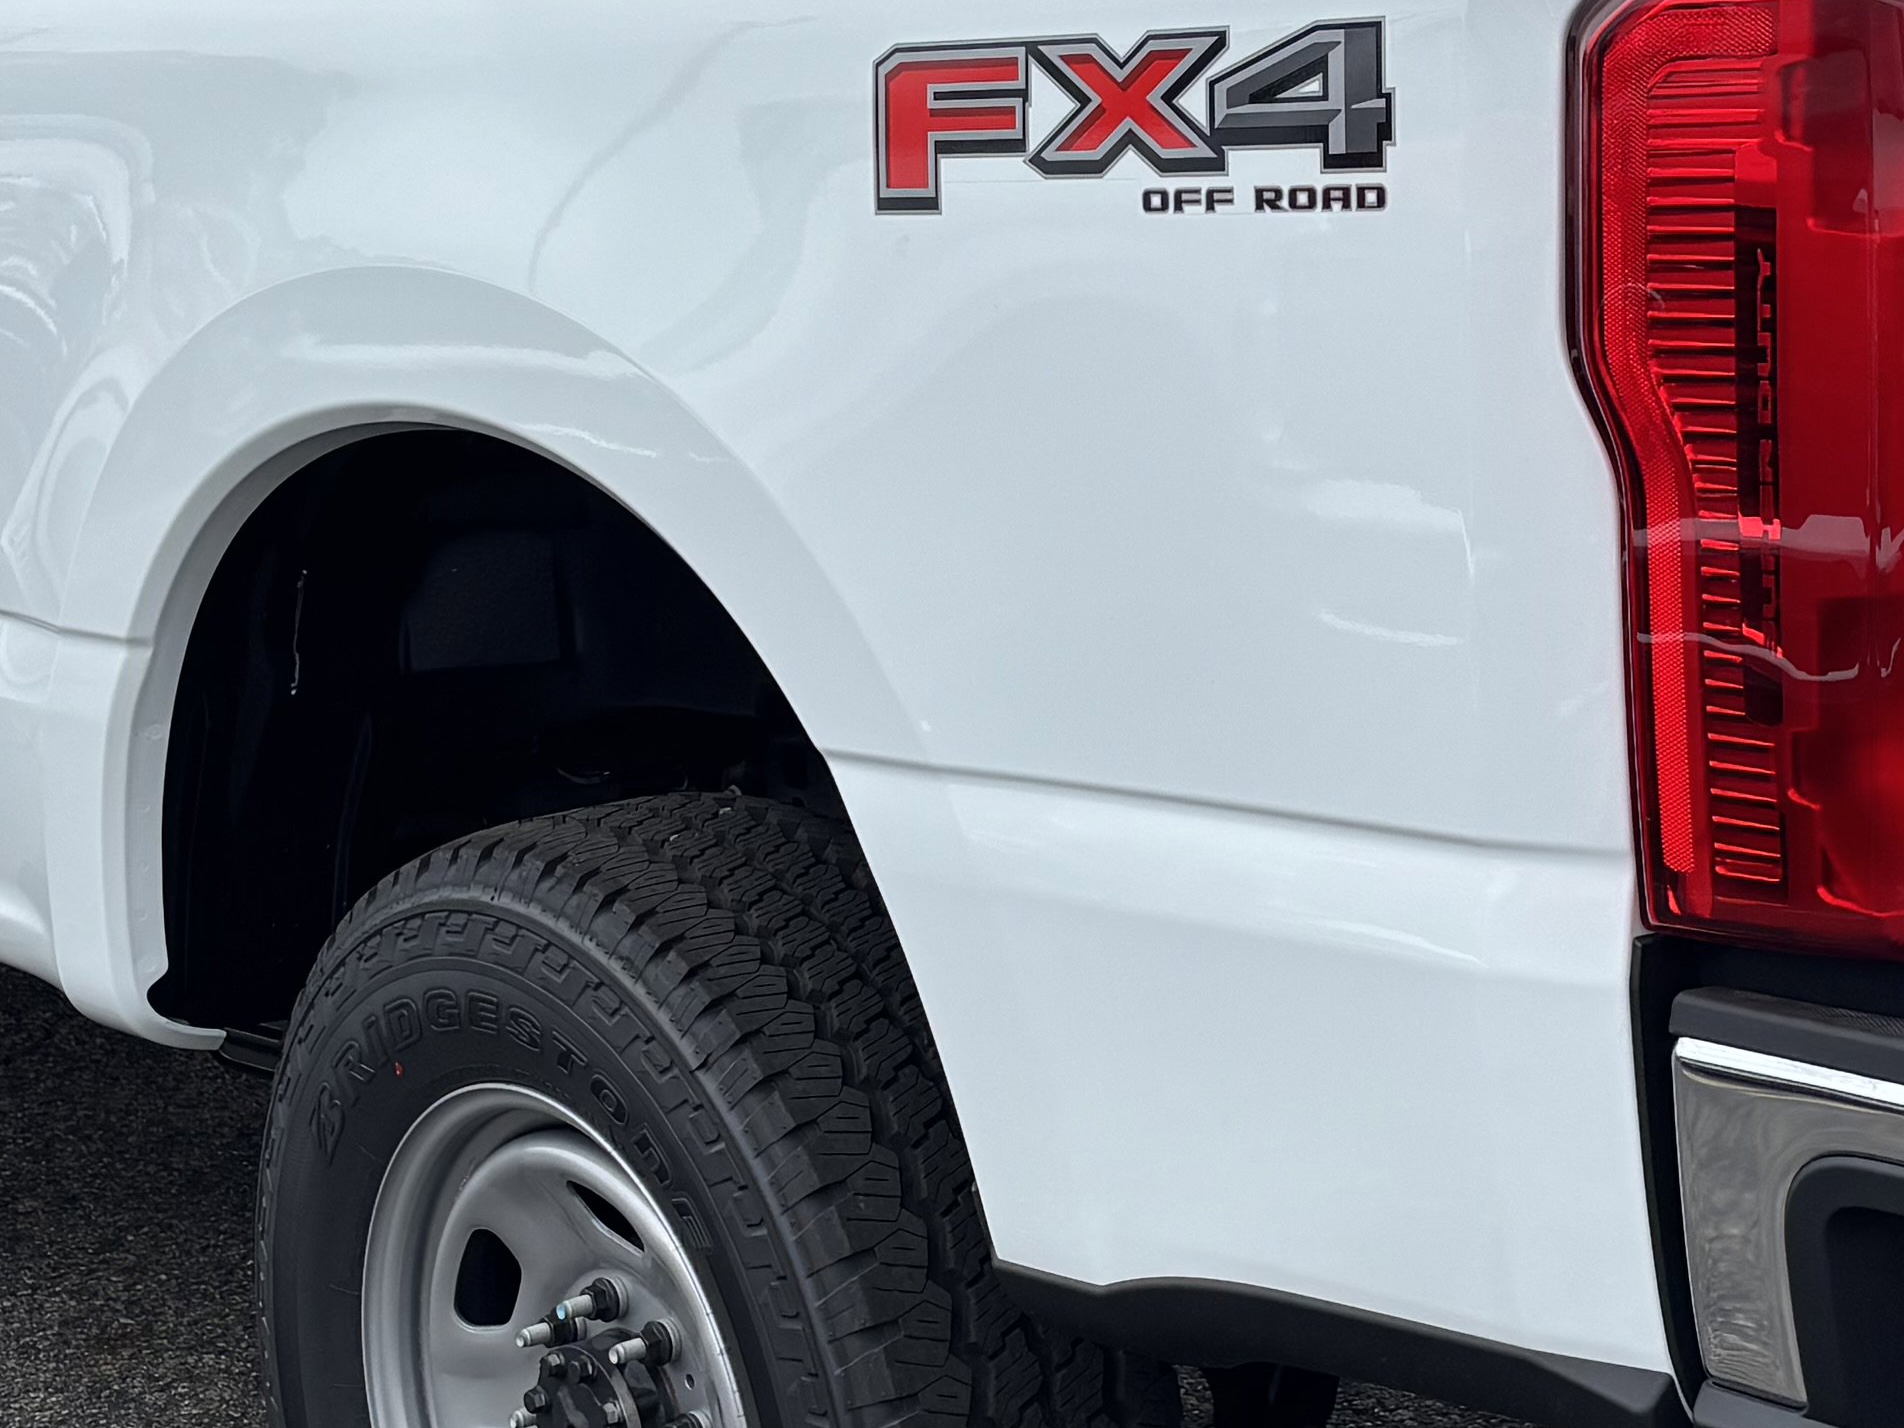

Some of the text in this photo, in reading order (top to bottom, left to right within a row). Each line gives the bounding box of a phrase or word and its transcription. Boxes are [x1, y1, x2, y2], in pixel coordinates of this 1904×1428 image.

[872, 16, 1396, 215] FX4
[1141, 182, 1388, 215] OFF ROAD
[308, 987, 714, 1255] BRIDGESTONE
